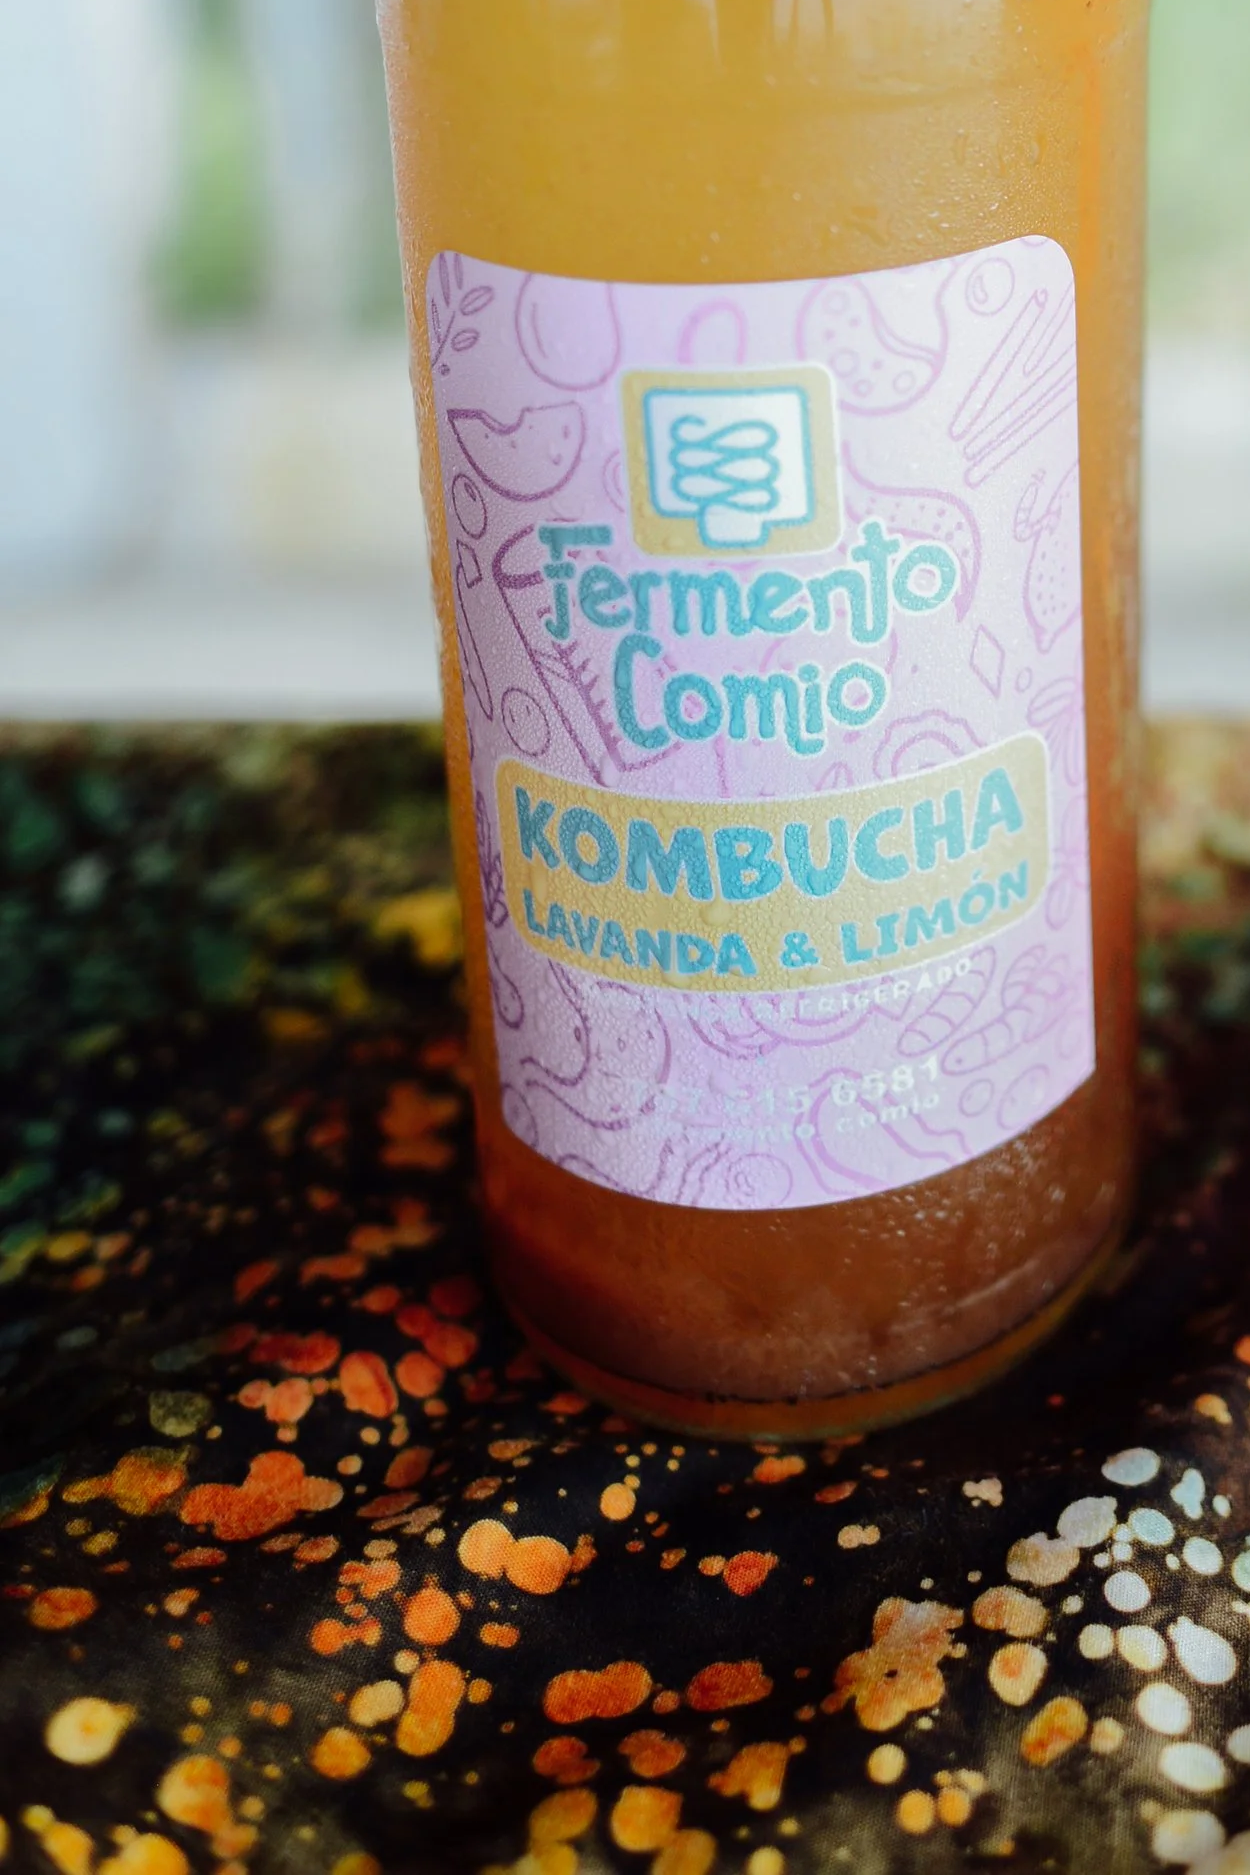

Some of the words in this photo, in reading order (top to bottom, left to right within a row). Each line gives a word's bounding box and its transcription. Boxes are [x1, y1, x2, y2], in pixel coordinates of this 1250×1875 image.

[612, 635, 887, 753] Comio
[515, 767, 1025, 902] KOMBUCHA
[522, 889, 757, 976] LAVANDA
[780, 931, 821, 971] &
[840, 859, 1030, 964] LIMÓN
